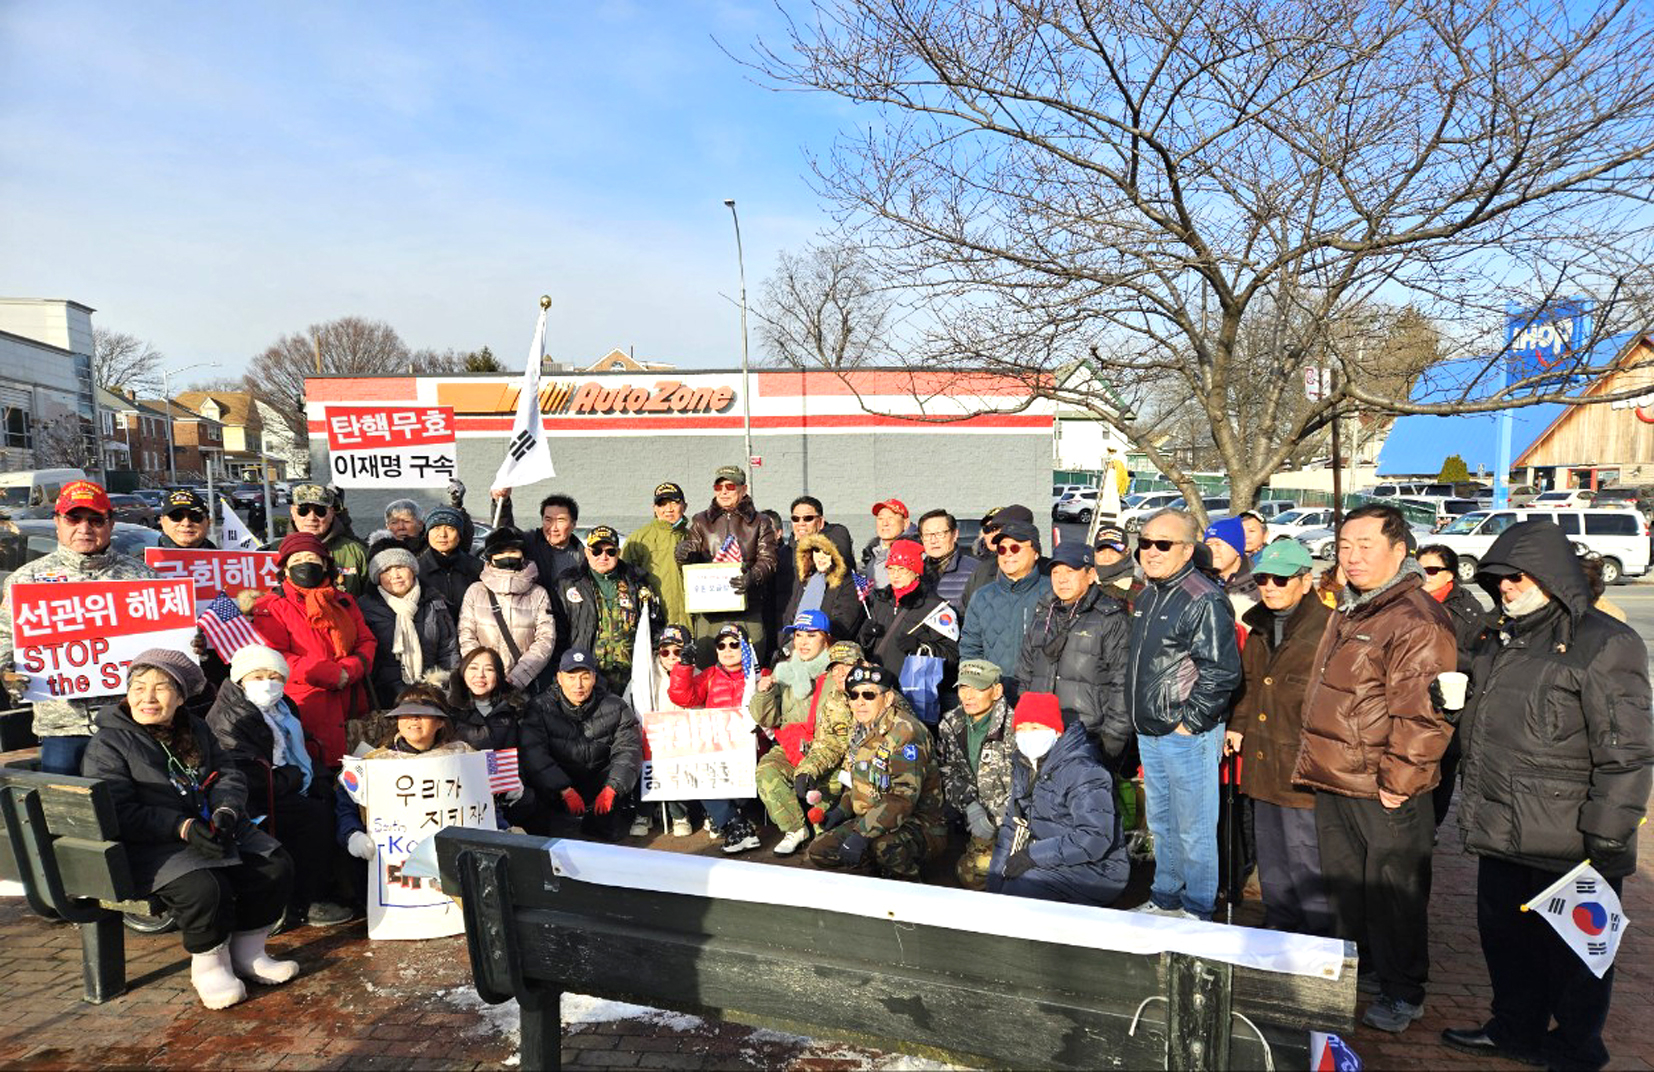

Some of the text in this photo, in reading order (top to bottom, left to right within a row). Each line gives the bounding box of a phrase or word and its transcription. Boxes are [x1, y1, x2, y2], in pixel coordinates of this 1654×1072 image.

[569, 380, 736, 414] AutoZone
[330, 410, 452, 444] 탄핵무효
[334, 454, 455, 479] 이재명 구속
[16, 583, 191, 637] 선관위 해체
[23, 637, 110, 674] STOP
[47, 673, 90, 697] the
